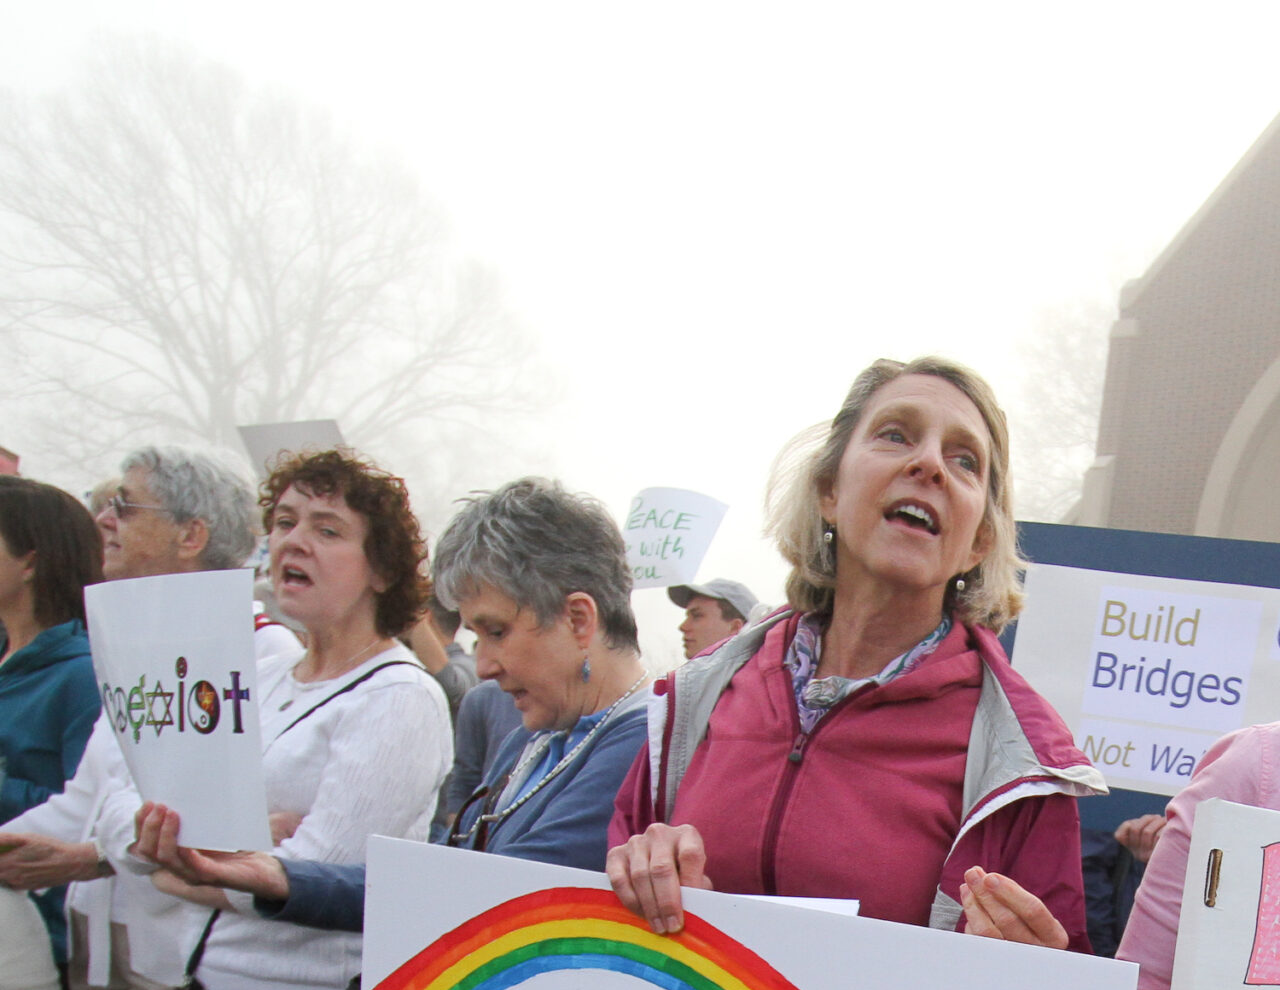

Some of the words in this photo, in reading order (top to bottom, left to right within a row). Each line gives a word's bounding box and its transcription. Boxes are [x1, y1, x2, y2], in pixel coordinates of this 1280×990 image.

[640, 535, 684, 560] with
[631, 566, 663, 580] ou
[1101, 599, 1201, 647] Build
[1092, 651, 1244, 708] Bridges
[1083, 734, 1136, 768] Not
[1150, 743, 1207, 777] Wa
